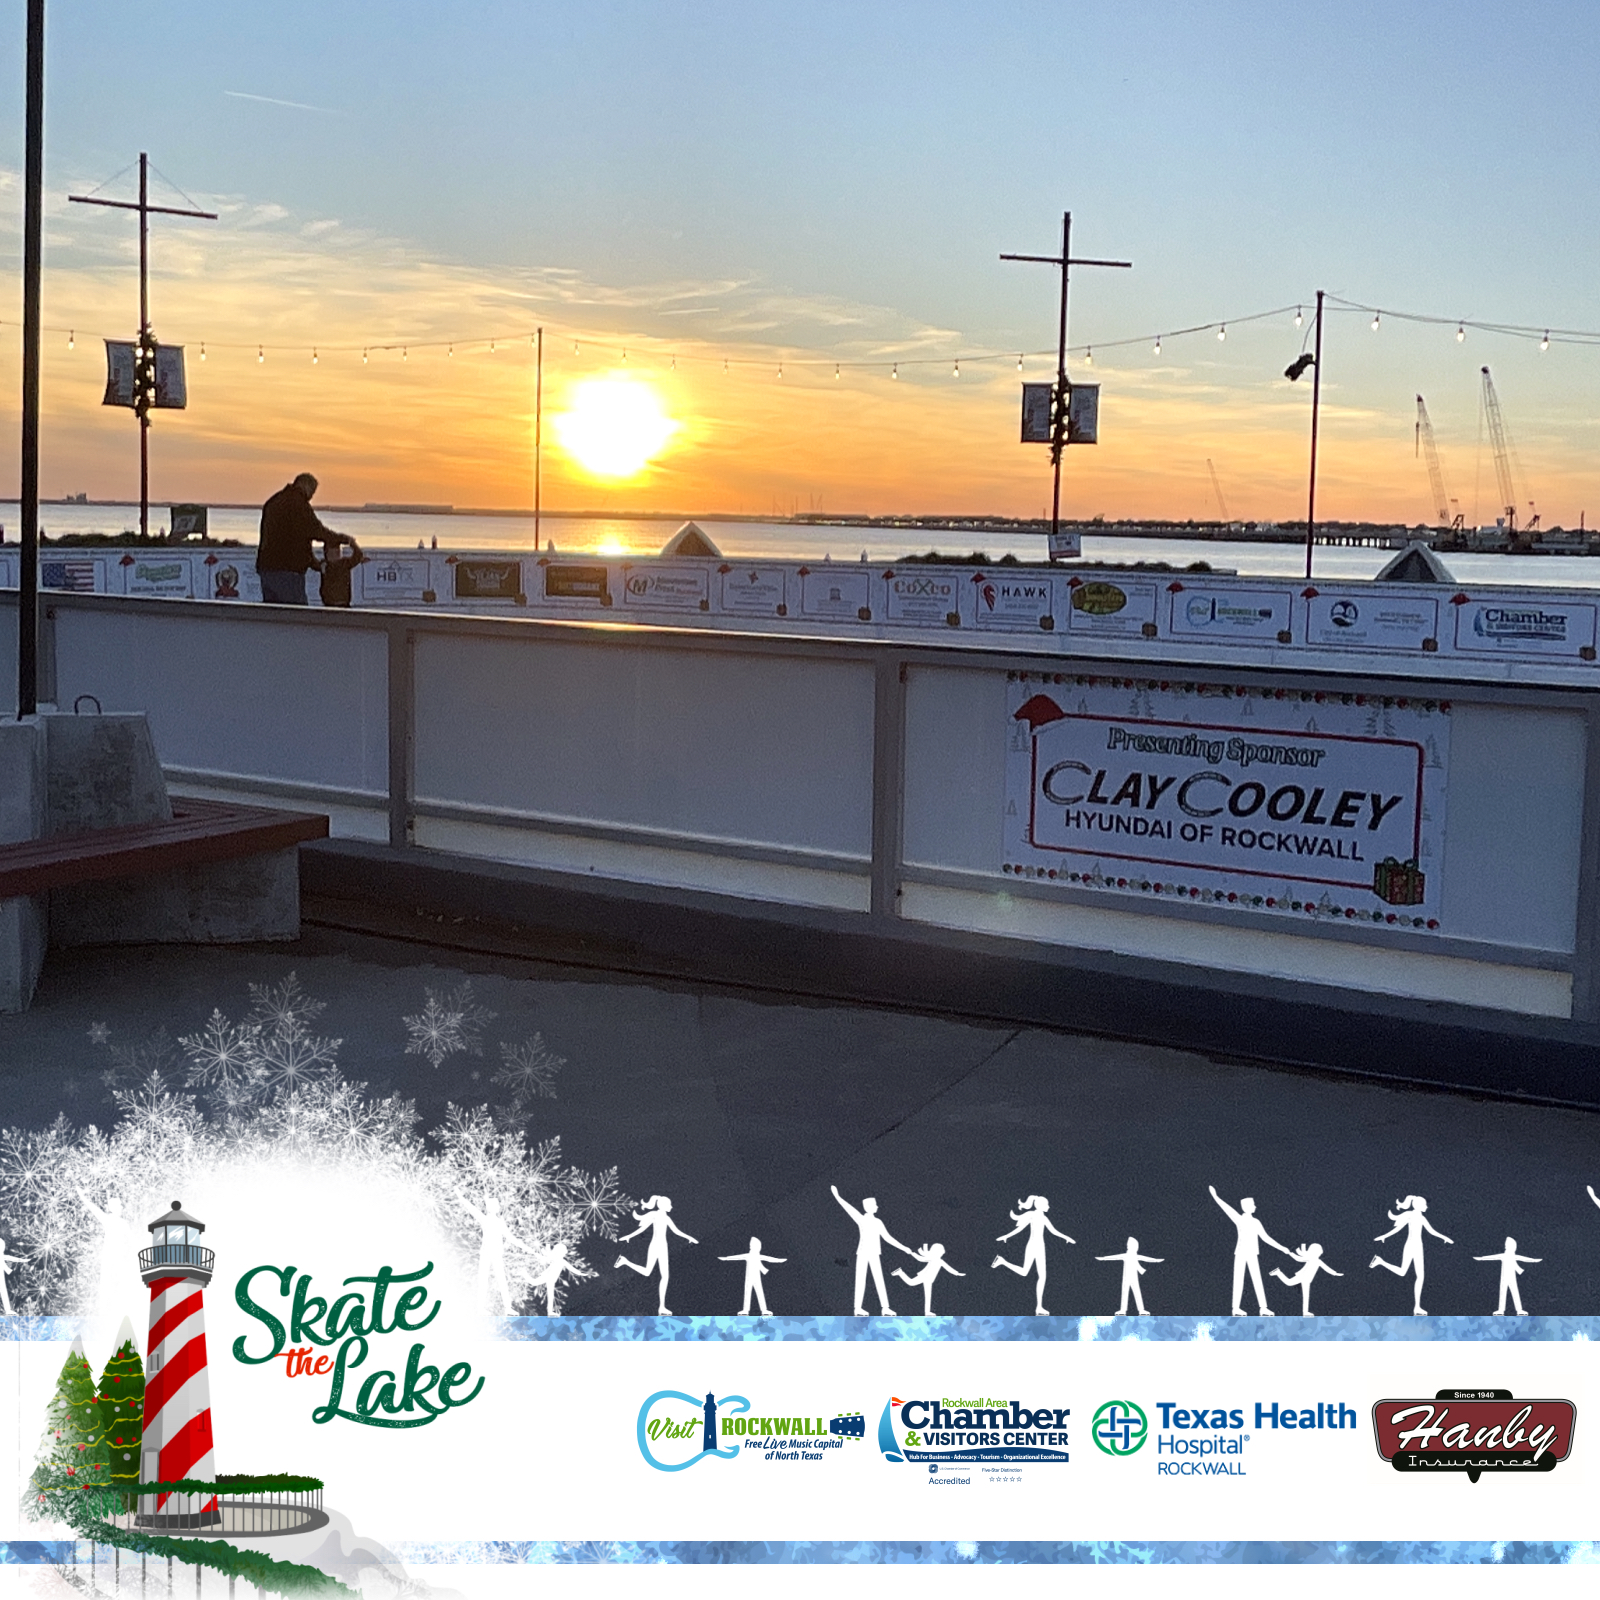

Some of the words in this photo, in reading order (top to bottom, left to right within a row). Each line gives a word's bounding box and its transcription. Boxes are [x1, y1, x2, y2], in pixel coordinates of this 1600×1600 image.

[1002, 586, 1046, 598] HAWK
[1486, 608, 1568, 624] Chamber
[1107, 727, 1223, 763] Presenting
[1226, 737, 1325, 767] Sponsor
[1042, 760, 1177, 809] CLAY
[1177, 771, 1402, 830] COOLEY
[1065, 809, 1172, 839] HYUNDAI
[1180, 824, 1213, 842] OF
[1221, 827, 1365, 861] ROCKWALL
